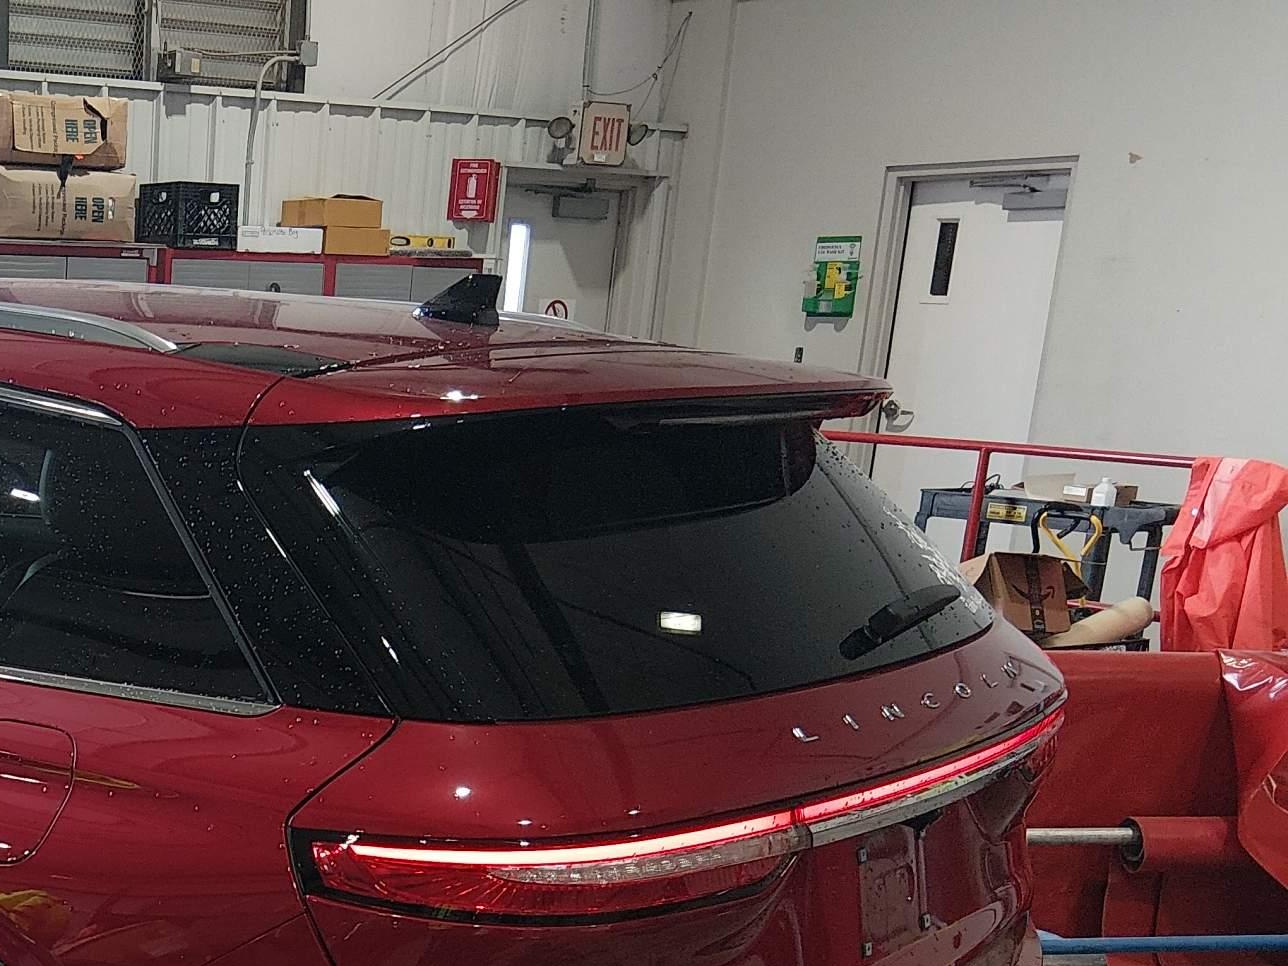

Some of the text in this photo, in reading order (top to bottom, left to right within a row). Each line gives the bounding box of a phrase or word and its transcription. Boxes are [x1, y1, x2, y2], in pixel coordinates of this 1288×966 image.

[65, 119, 79, 143] HERE
[83, 119, 98, 145] OPEN
[591, 116, 624, 152] EXIT
[75, 196, 88, 221] HERE
[92, 197, 105, 223] OPEN
[792, 661, 1020, 743] LINCOLN
